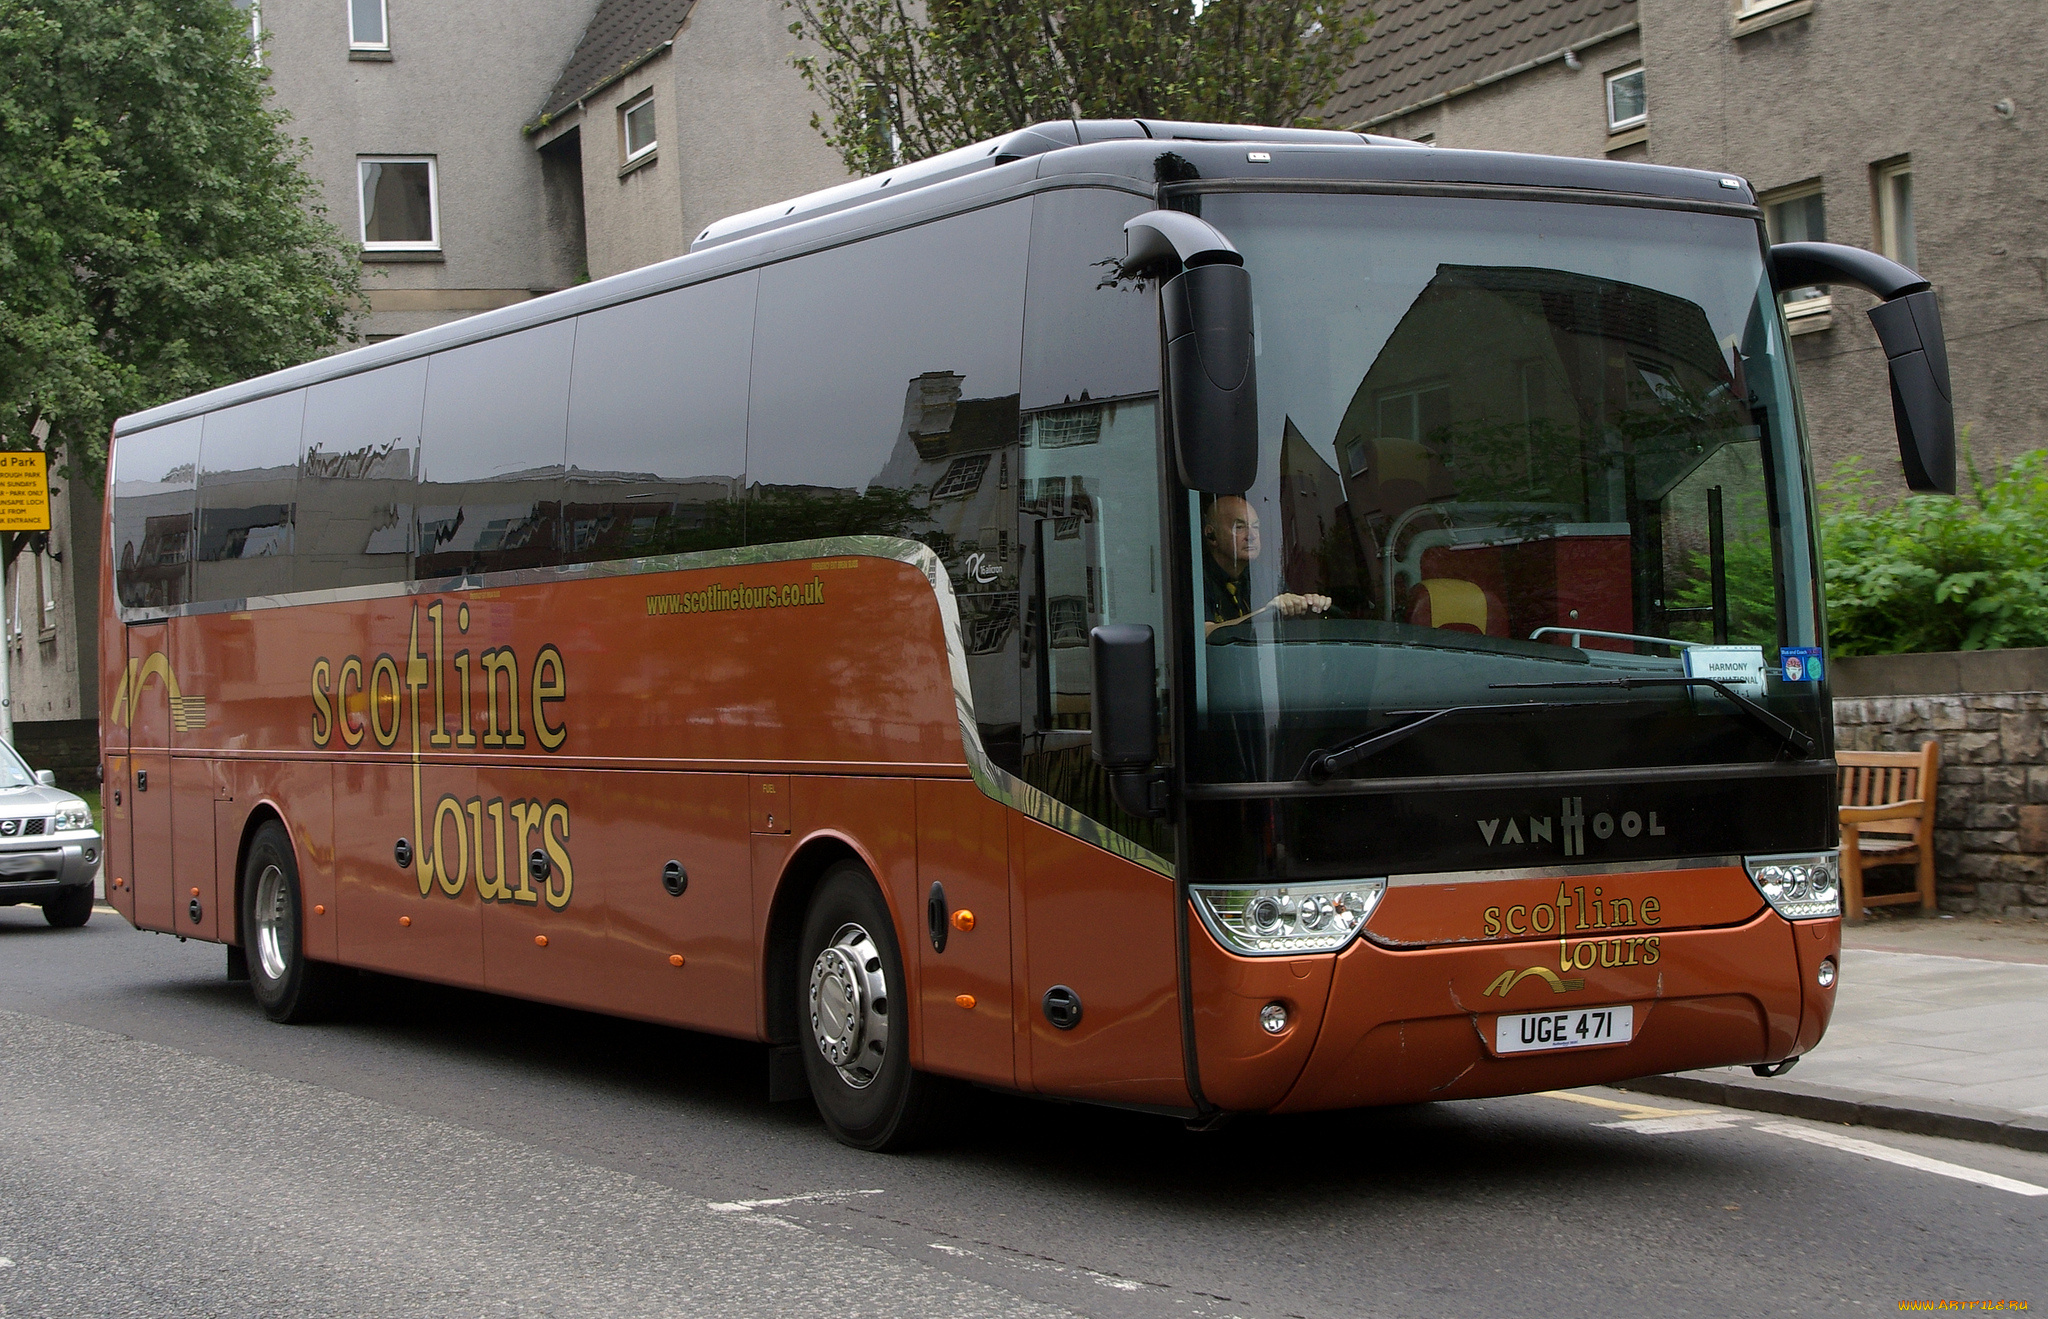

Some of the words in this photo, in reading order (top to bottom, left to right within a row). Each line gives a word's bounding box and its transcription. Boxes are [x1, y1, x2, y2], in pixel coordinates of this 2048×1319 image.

[11, 457, 36, 467] Park
[646, 576, 825, 616] www.scotlinetours.co.uk
[311, 599, 567, 753] scotline
[1709, 663, 1748, 672] HARMONY
[762, 783, 776, 794] FUEL
[412, 792, 574, 912] tours
[1483, 881, 1661, 937] scotline
[1558, 935, 1662, 973] tours
[1520, 1014, 1569, 1044] UGE
[1575, 1011, 1612, 1040] 471
